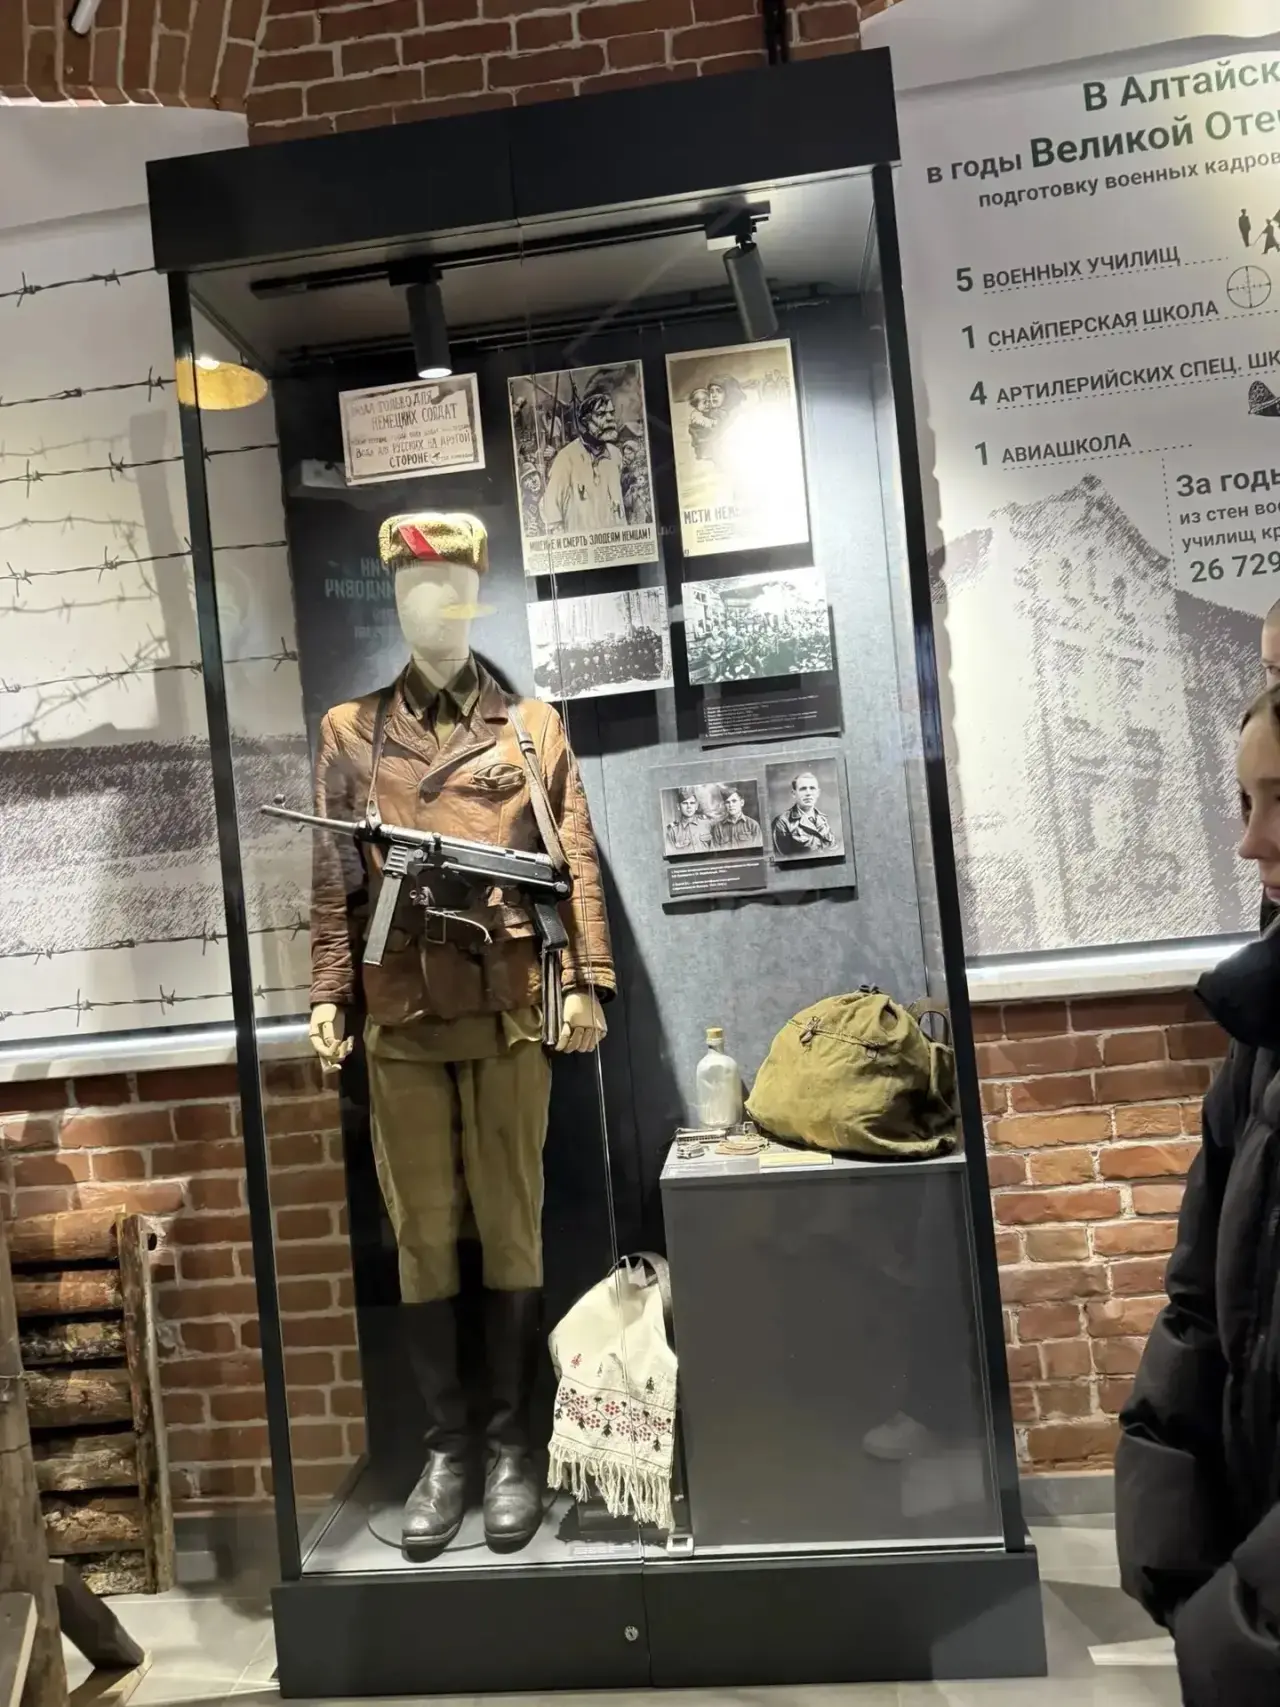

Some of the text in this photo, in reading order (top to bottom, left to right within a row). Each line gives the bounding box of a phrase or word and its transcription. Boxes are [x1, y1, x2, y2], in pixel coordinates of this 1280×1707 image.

[1083, 60, 1280, 112] В Алтайск
[926, 108, 1280, 184] в годы Великой Оте
[978, 150, 1280, 208] подготовку военных кадров
[956, 246, 1181, 292] 5 ВОЕННЫХ УЧИЛИЩ
[961, 301, 1219, 349] 1 СНАЙПЕРСКАЯ ШКОЛА
[969, 349, 1280, 405] 4 АРТИЛЕРИЙСКИХ СПЕЦ. ШК
[422, 402, 458, 423] СОЛДАТ
[389, 452, 429, 468] СТОРОНЕ
[975, 433, 1132, 466] 1 АВИАШКОЛА
[1176, 474, 1212, 497] За
[683, 508, 711, 525] МСТИ
[1179, 501, 1280, 525] из стен во
[563, 537, 588, 549] СМЕРТЬ
[589, 532, 621, 546] ЗЛОДЕЯМ
[622, 527, 651, 542] НЕМЦАМ!
[1182, 528, 1257, 553] училищ
[1190, 551, 1280, 583] 26 729
